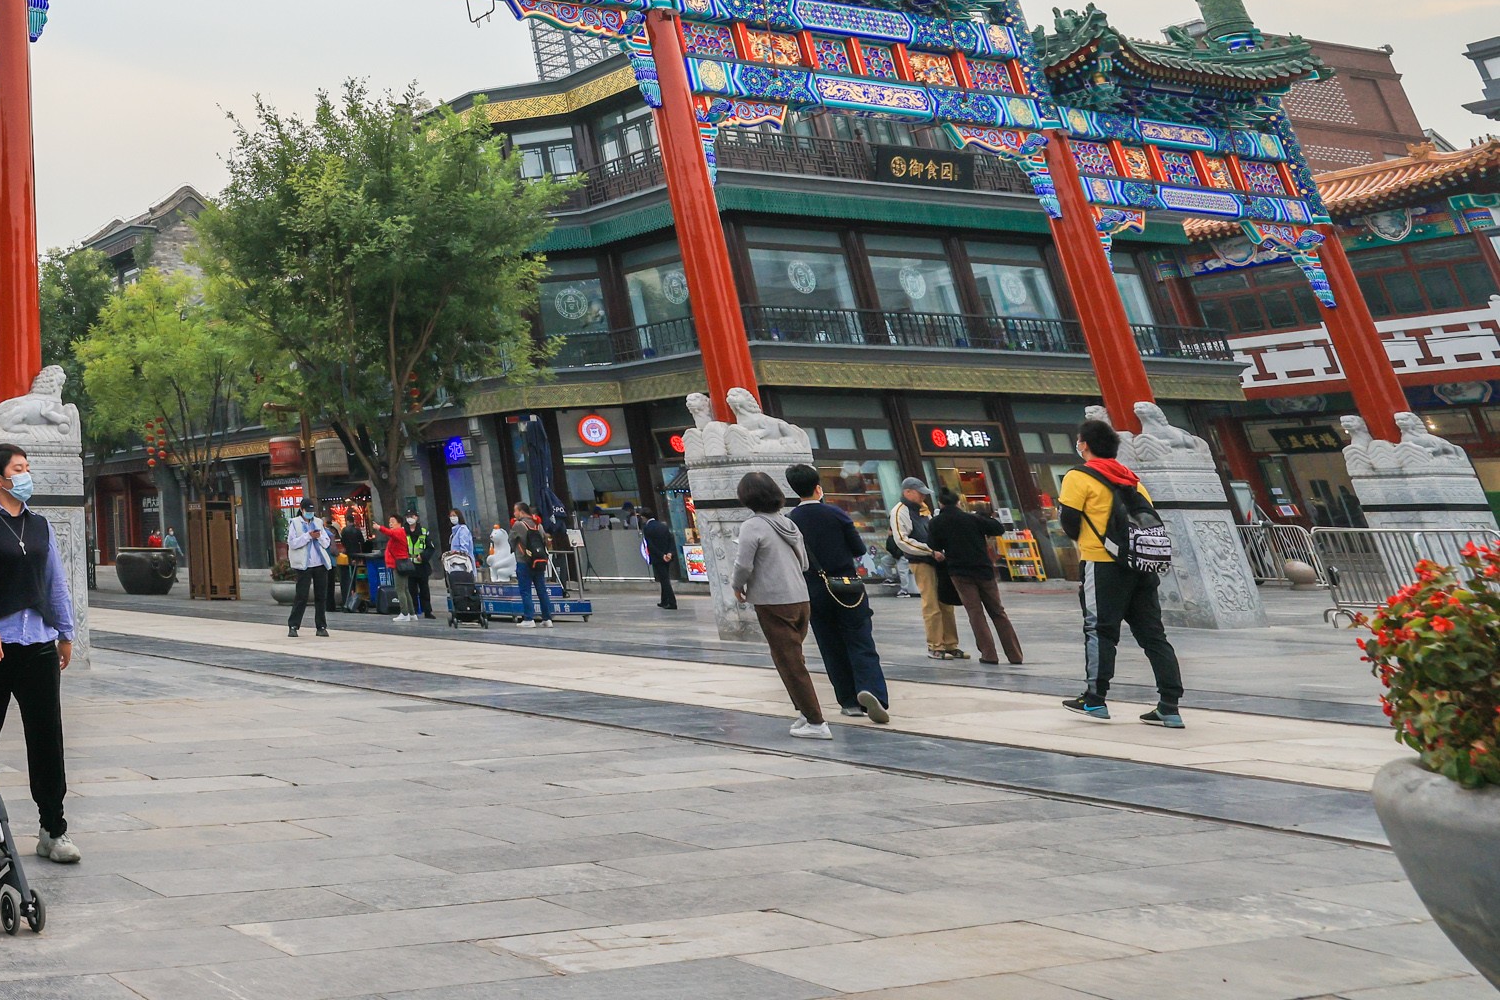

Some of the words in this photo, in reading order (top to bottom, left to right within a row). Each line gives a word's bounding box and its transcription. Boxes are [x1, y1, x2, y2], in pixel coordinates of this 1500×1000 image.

[908, 158, 953, 181] 御食园
[946, 429, 985, 448] 御食园
